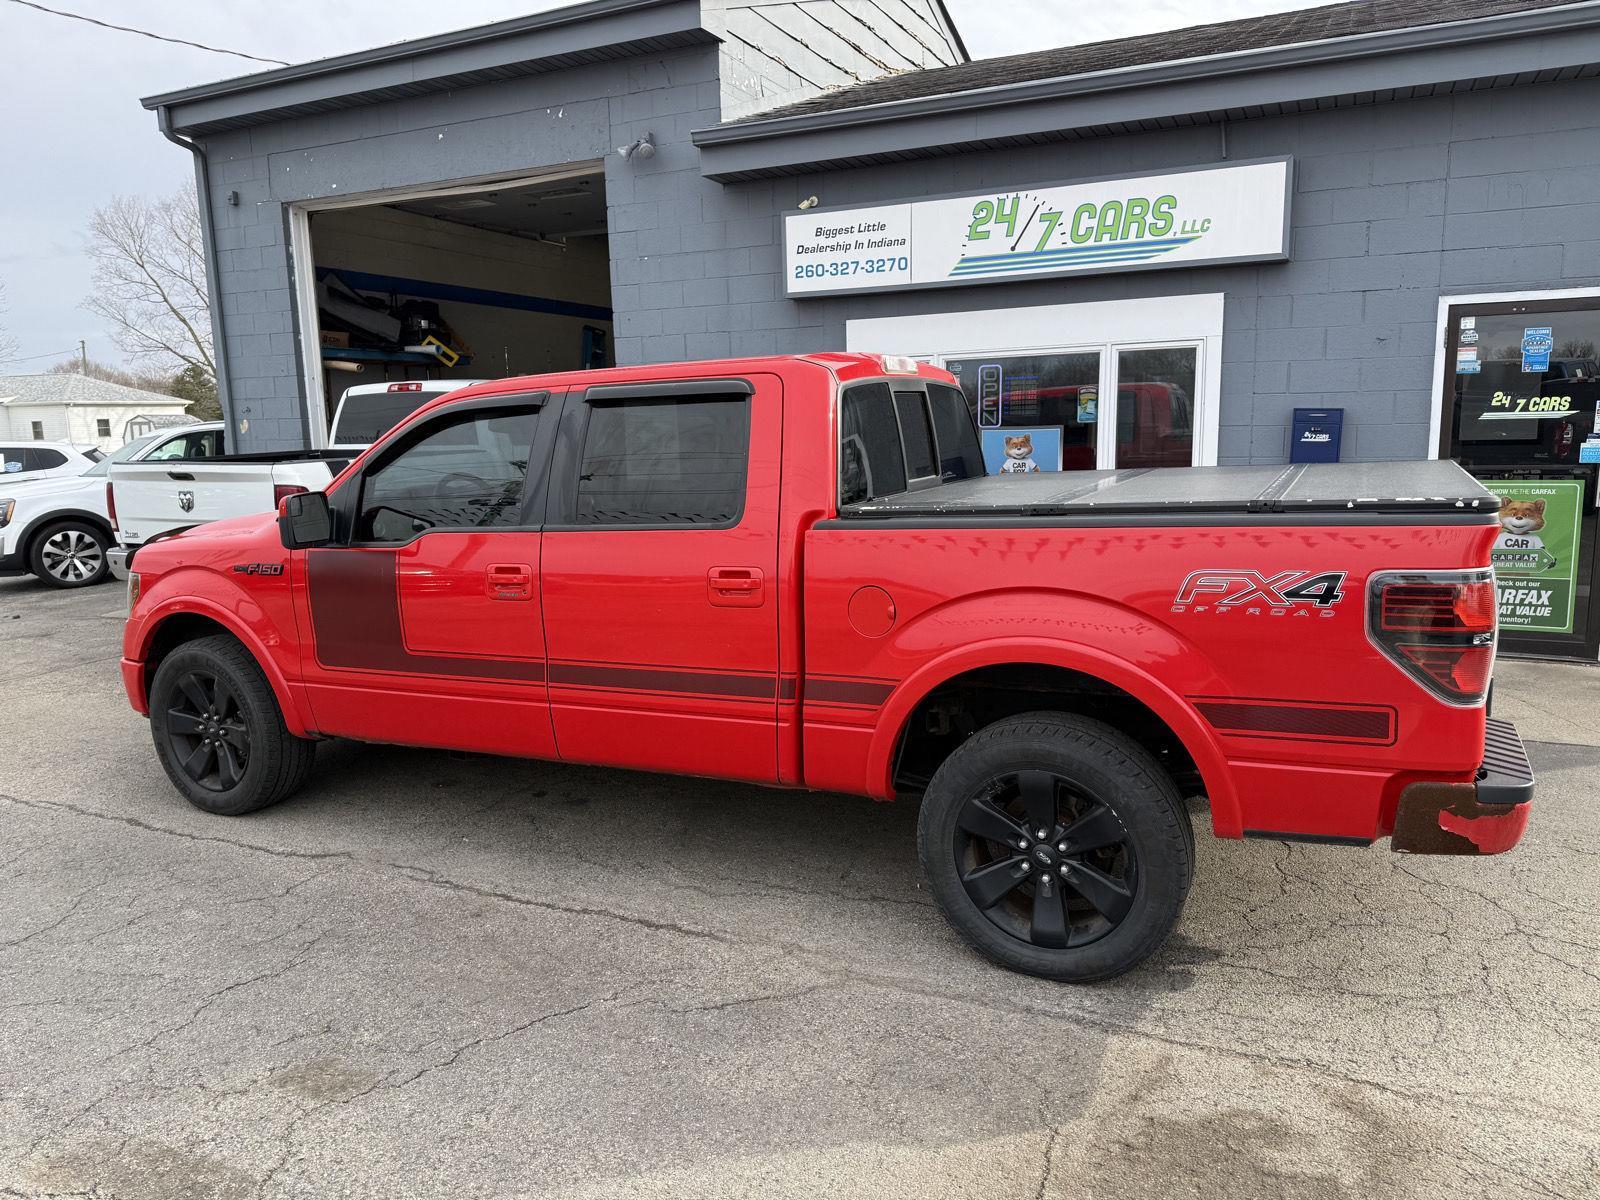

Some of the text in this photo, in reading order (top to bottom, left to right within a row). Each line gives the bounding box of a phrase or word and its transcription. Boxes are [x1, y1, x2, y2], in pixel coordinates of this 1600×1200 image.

[815, 221, 886, 239] Biggest Little
[1180, 218, 1212, 235] LLC
[796, 237, 906, 255] Dealership In Indiana
[795, 256, 908, 279] 260-327-3270
[982, 369, 997, 425] OPEN
[1491, 391, 1572, 413] 24 7 CARS
[1504, 538, 1530, 549] CAR
[1491, 553, 1539, 562] CARFAX
[1174, 568, 1349, 608] FX4
[1245, 607, 1336, 618] ROAD
[1515, 605, 1553, 617] VALUE
